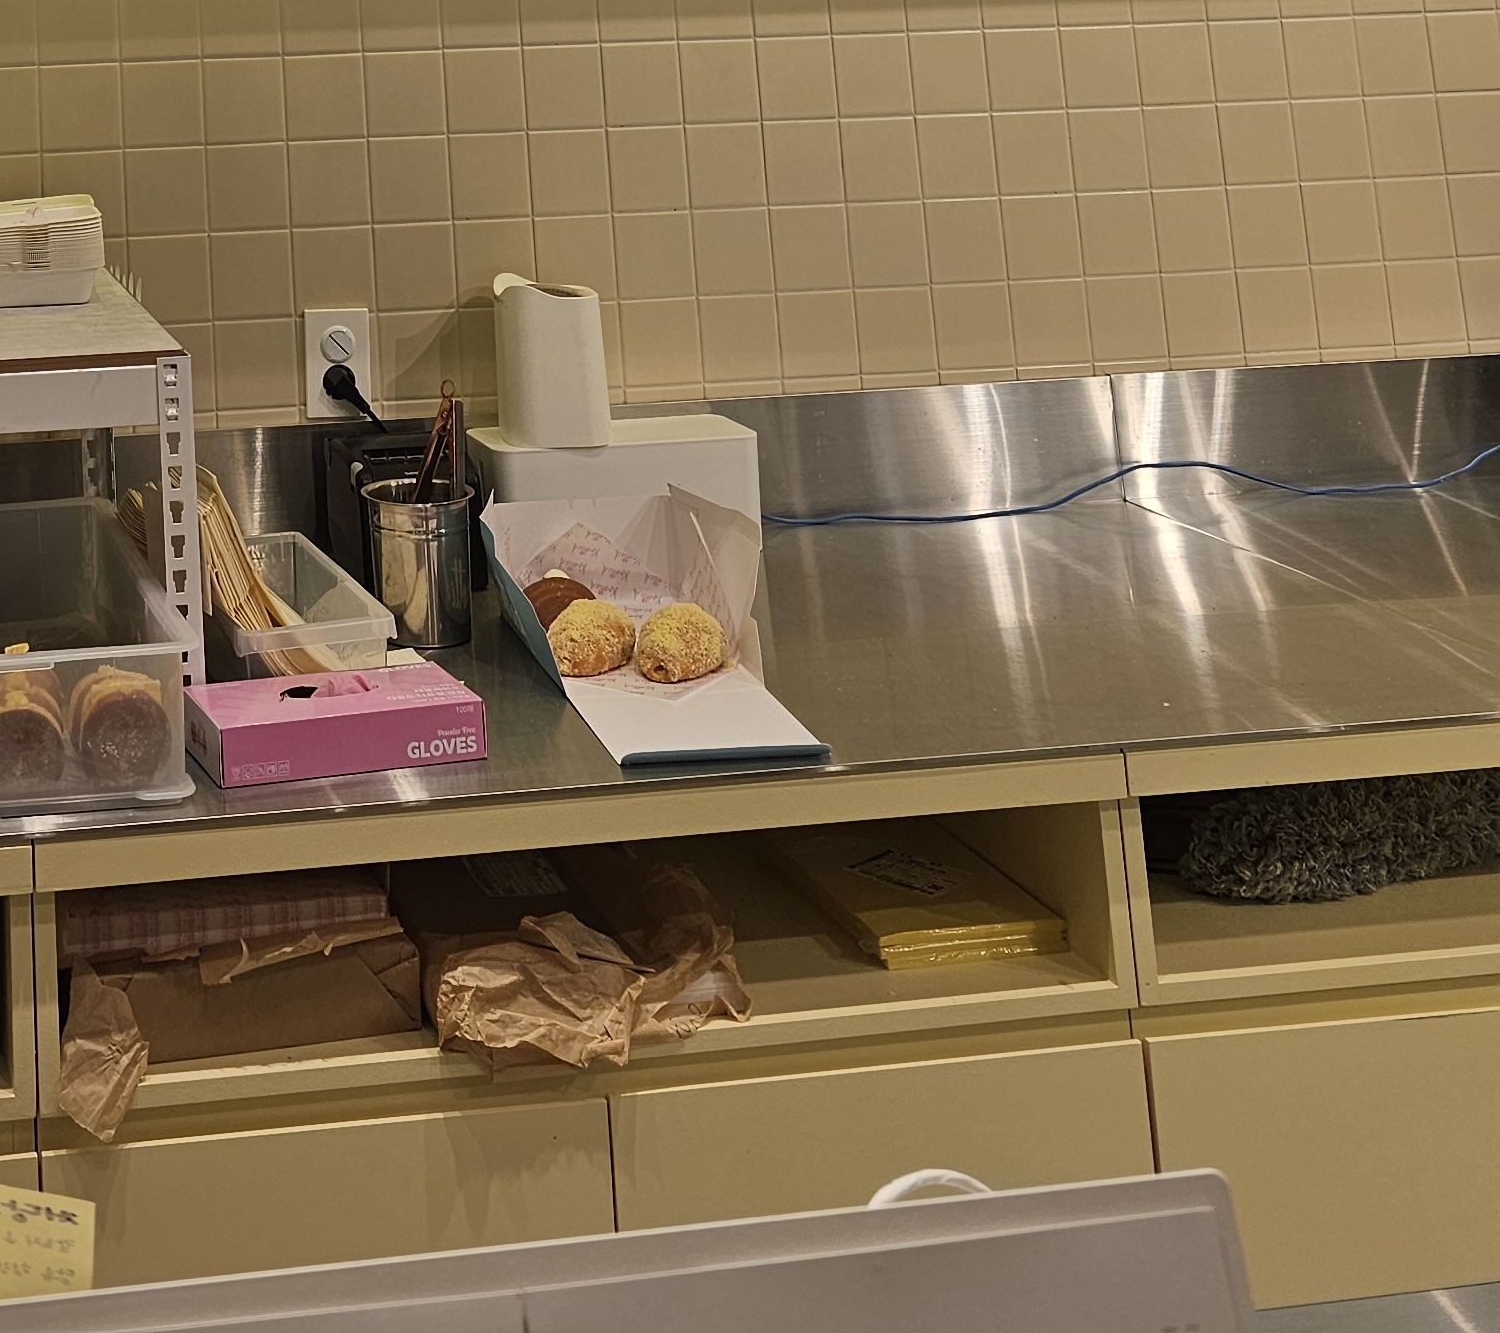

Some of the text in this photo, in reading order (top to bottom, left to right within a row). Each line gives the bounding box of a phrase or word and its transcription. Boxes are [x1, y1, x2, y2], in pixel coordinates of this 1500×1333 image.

[438, 726, 476, 737] Powder Free
[407, 736, 478, 759] GLOVES
